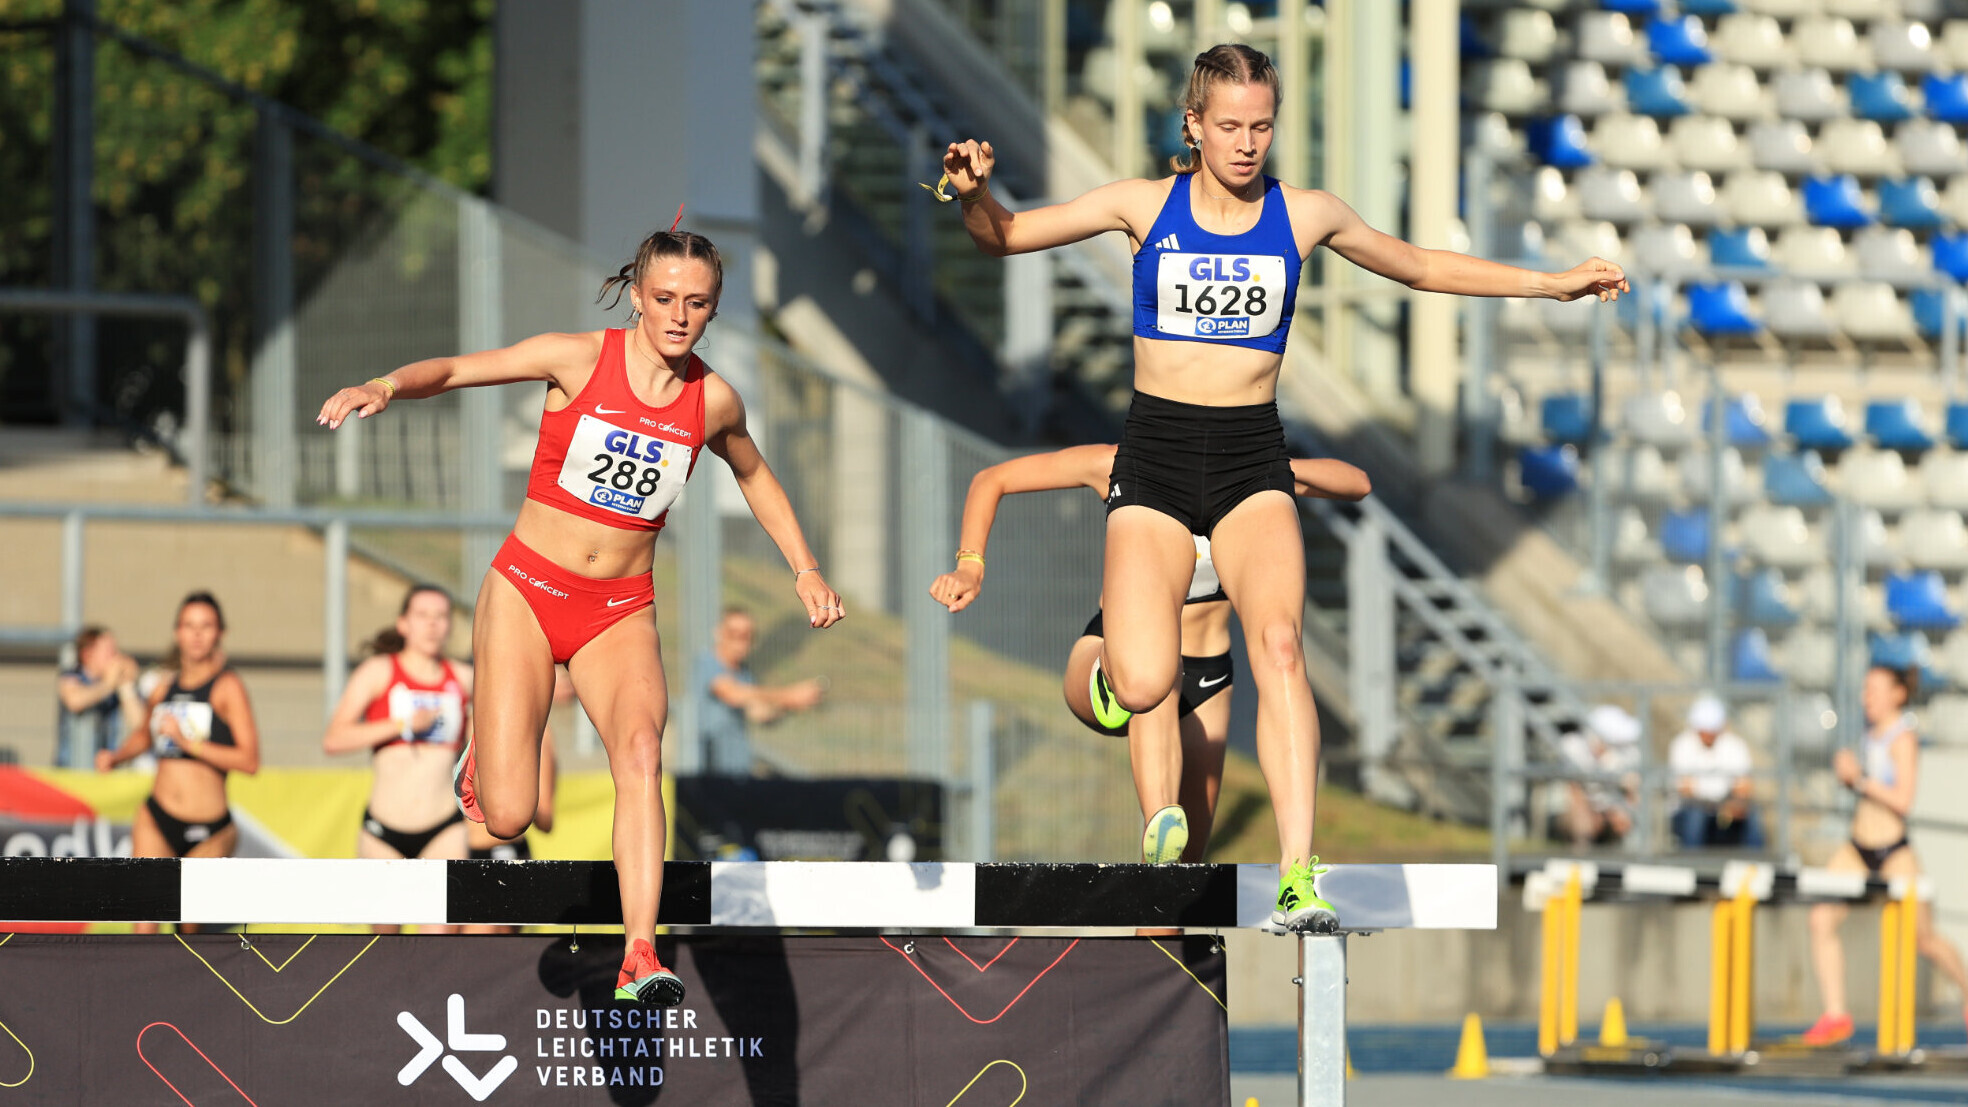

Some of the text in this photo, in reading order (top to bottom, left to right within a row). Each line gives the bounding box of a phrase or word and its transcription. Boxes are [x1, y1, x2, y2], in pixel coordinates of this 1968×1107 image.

[1175, 284, 1267, 316] 1628
[1218, 320, 1248, 330] PLAN
[639, 416, 692, 439] PRO CONCEPT
[587, 453, 661, 497] 288
[613, 493, 642, 508] PLAN
[508, 564, 569, 600] PRO CONCEPT
[536, 1009, 698, 1029] DEUTSCHER
[536, 1037, 764, 1058] LEICHTATHLETIK
[536, 1066, 664, 1086] VERBAND
